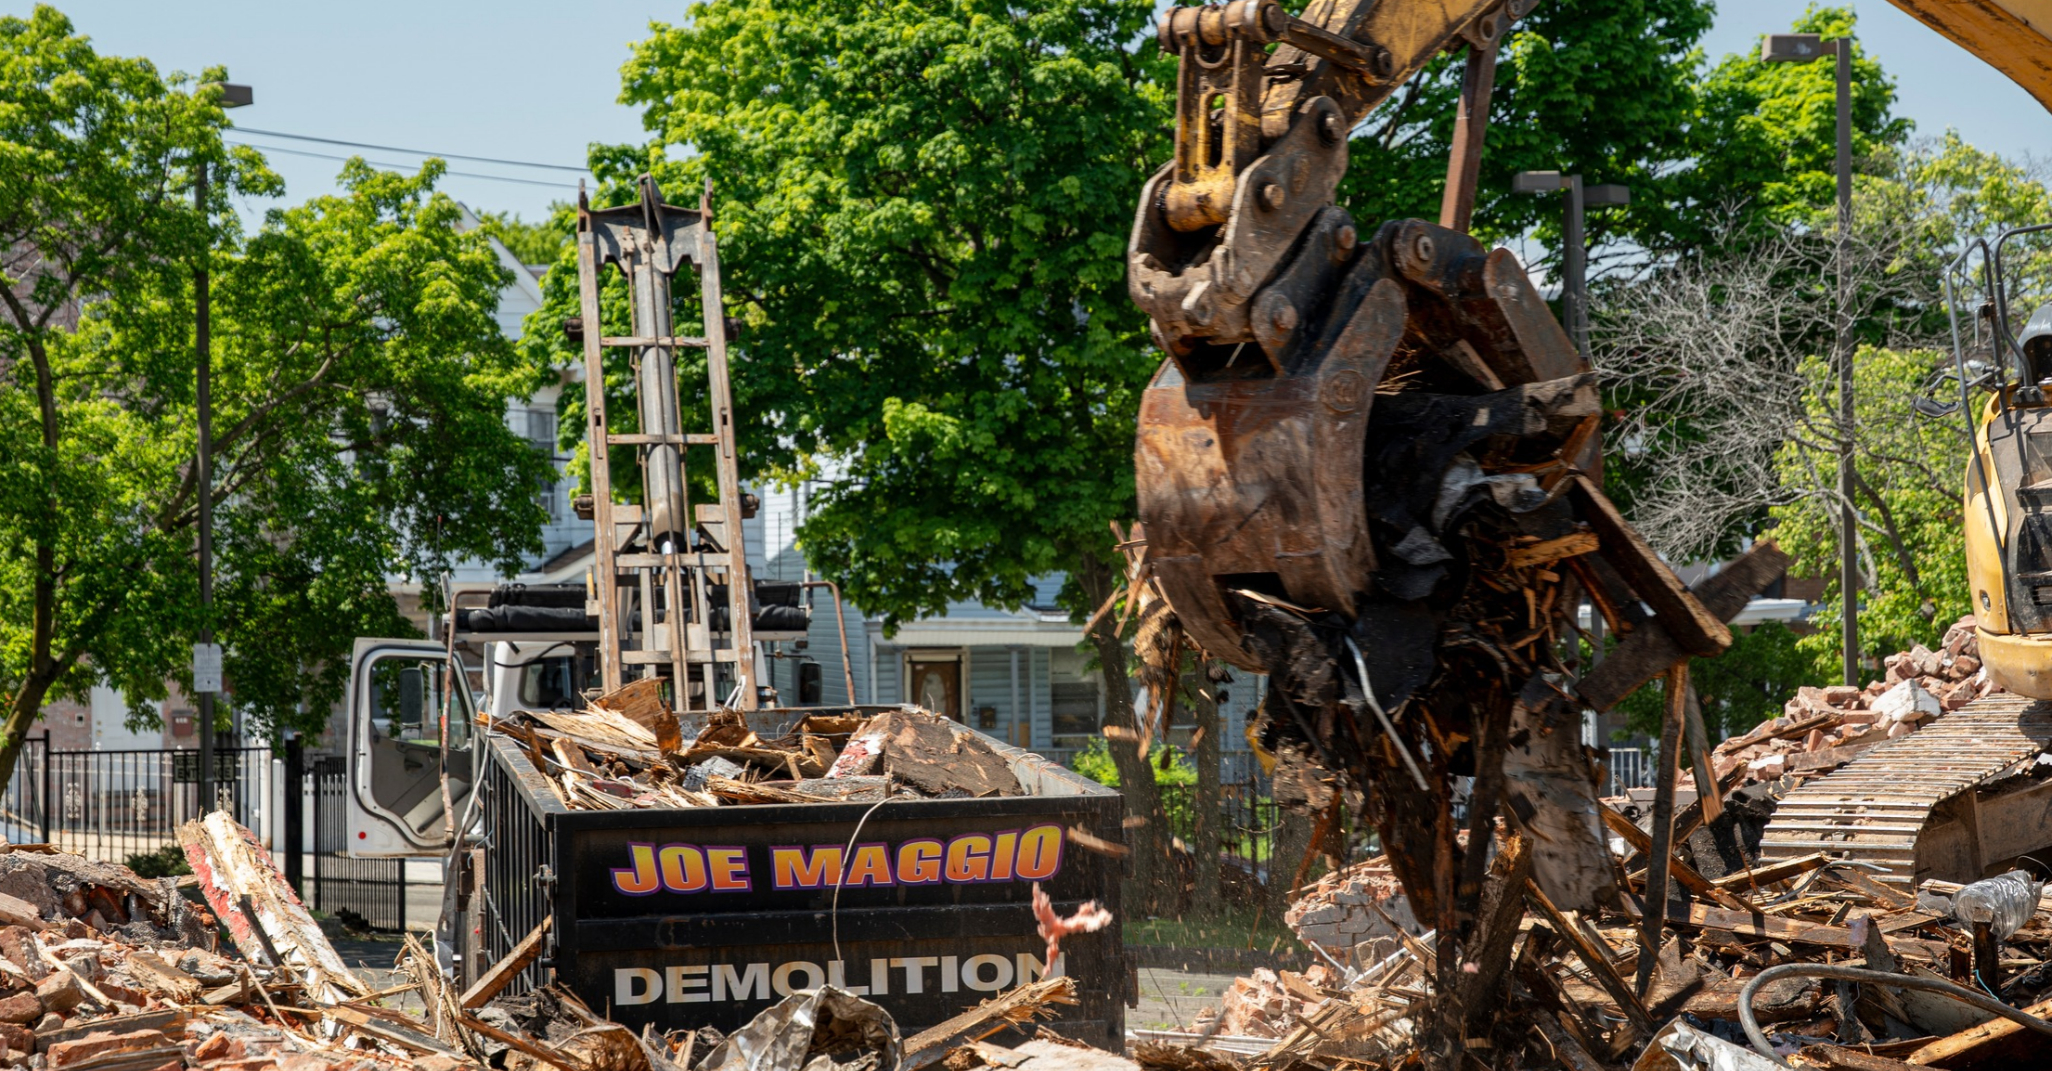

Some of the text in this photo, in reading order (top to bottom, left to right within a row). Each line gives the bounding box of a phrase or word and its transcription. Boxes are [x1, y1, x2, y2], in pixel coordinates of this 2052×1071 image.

[178, 767, 231, 779] ENTNCE
[610, 822, 1065, 896] JOE MAGGIO
[615, 952, 1065, 1005] DEMOLITION
